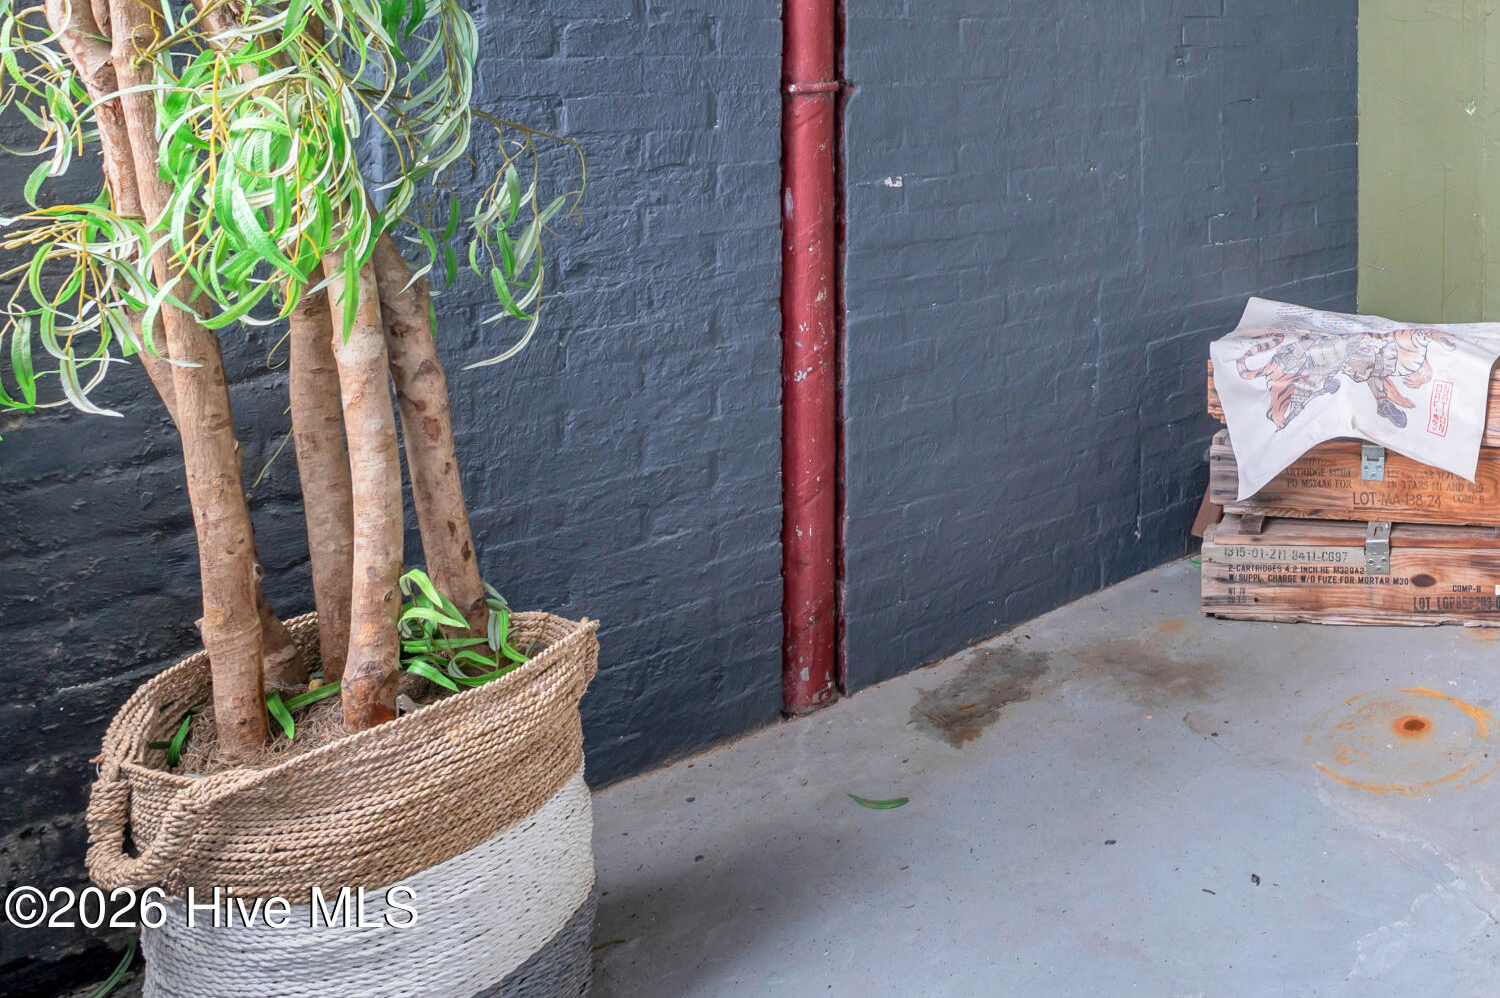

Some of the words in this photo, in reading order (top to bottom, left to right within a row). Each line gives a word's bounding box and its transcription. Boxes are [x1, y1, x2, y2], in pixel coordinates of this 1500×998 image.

[1285, 467, 1327, 477] ARTRIDGE
[1335, 479, 1353, 489] FOR
[1300, 565, 1319, 574] INCH
[1320, 565, 1331, 575] HE
[1267, 574, 1298, 584] CHARGE
[1317, 575, 1338, 585] FUZE
[1339, 576, 1355, 585] FOR
[1358, 577, 1390, 586] MORTAR
[1392, 578, 1409, 586] M30
[1452, 584, 1482, 593] COMP-B
[1413, 596, 1432, 611] LOT
